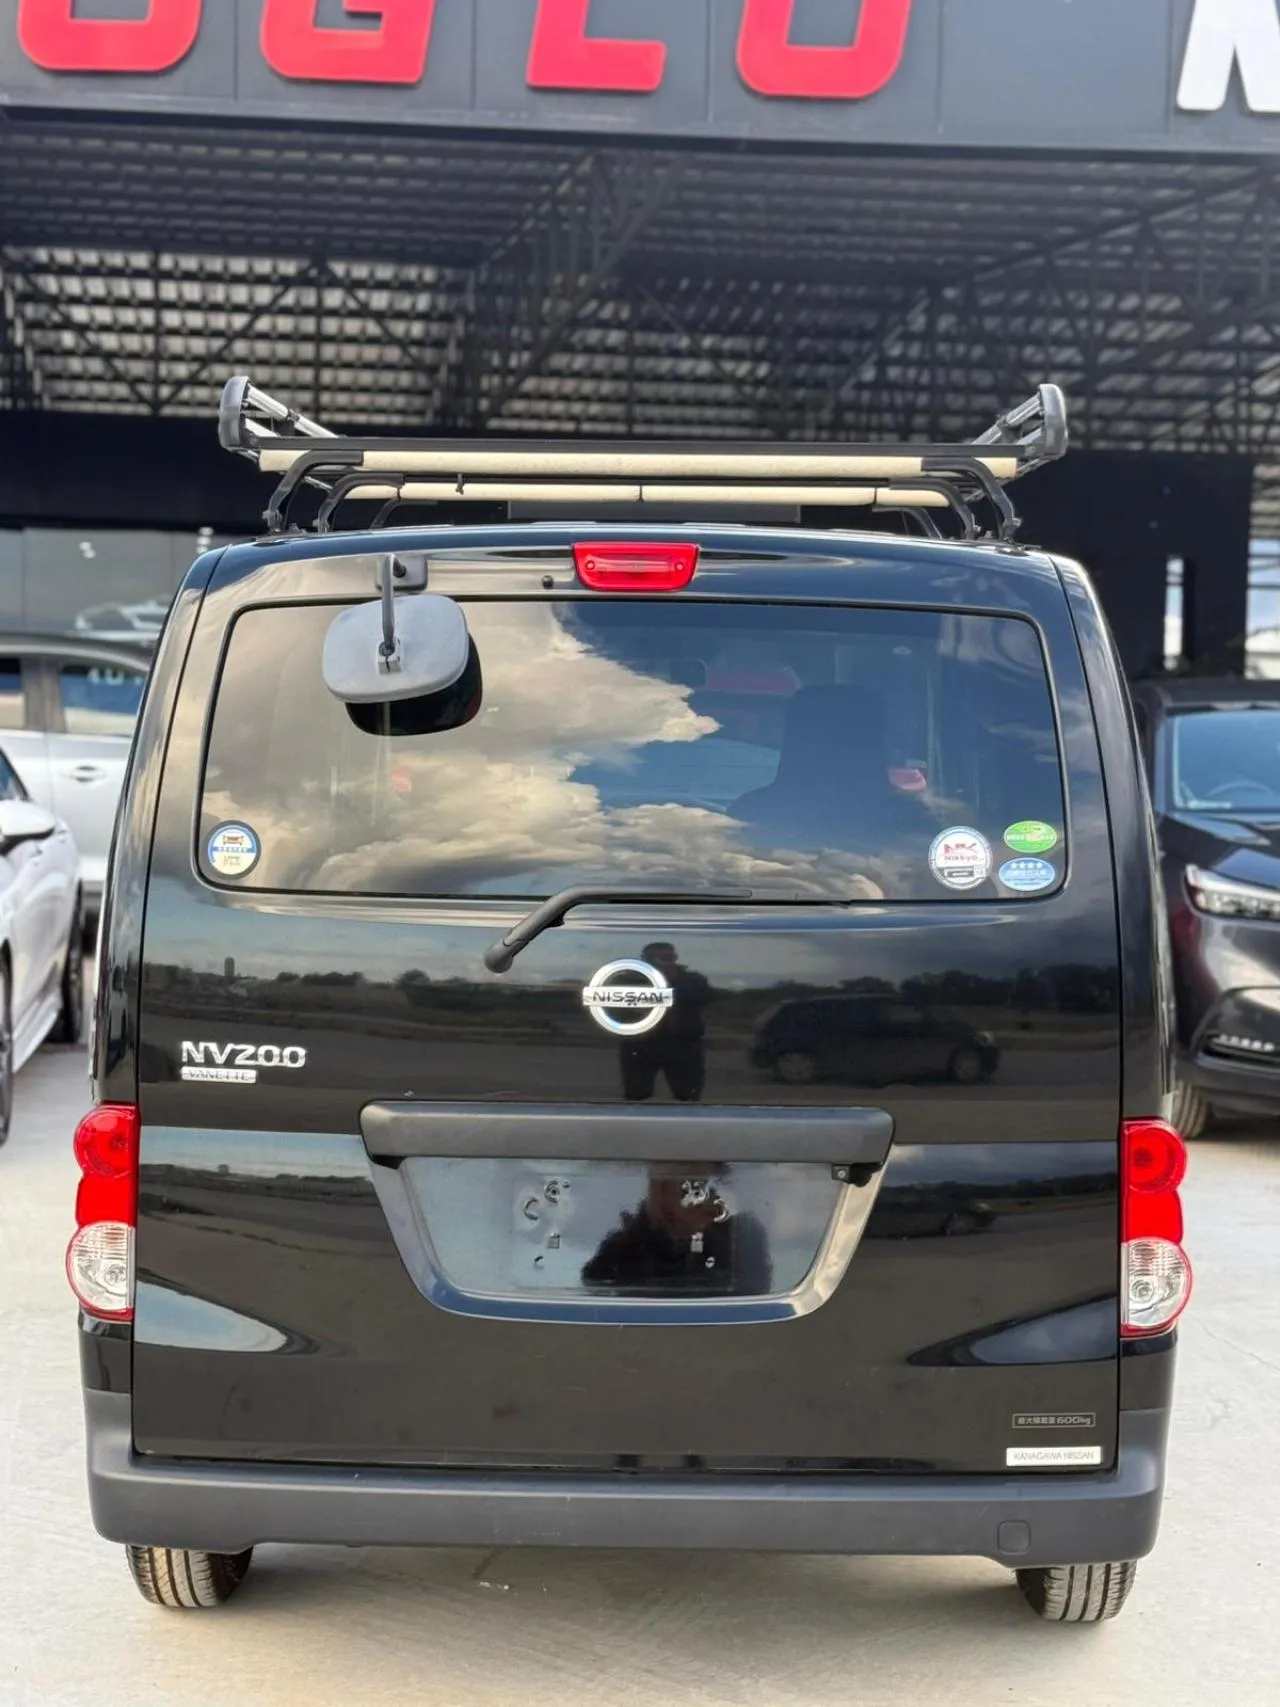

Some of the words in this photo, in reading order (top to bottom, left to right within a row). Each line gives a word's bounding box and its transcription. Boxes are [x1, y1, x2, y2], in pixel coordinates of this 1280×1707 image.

[592, 991, 664, 1003] NISSAN
[181, 1041, 306, 1068] NV200
[188, 1069, 256, 1081] VANETTE
[1013, 1451, 1062, 1461] KANAGAWA
[1063, 1450, 1095, 1461] NISSAN
